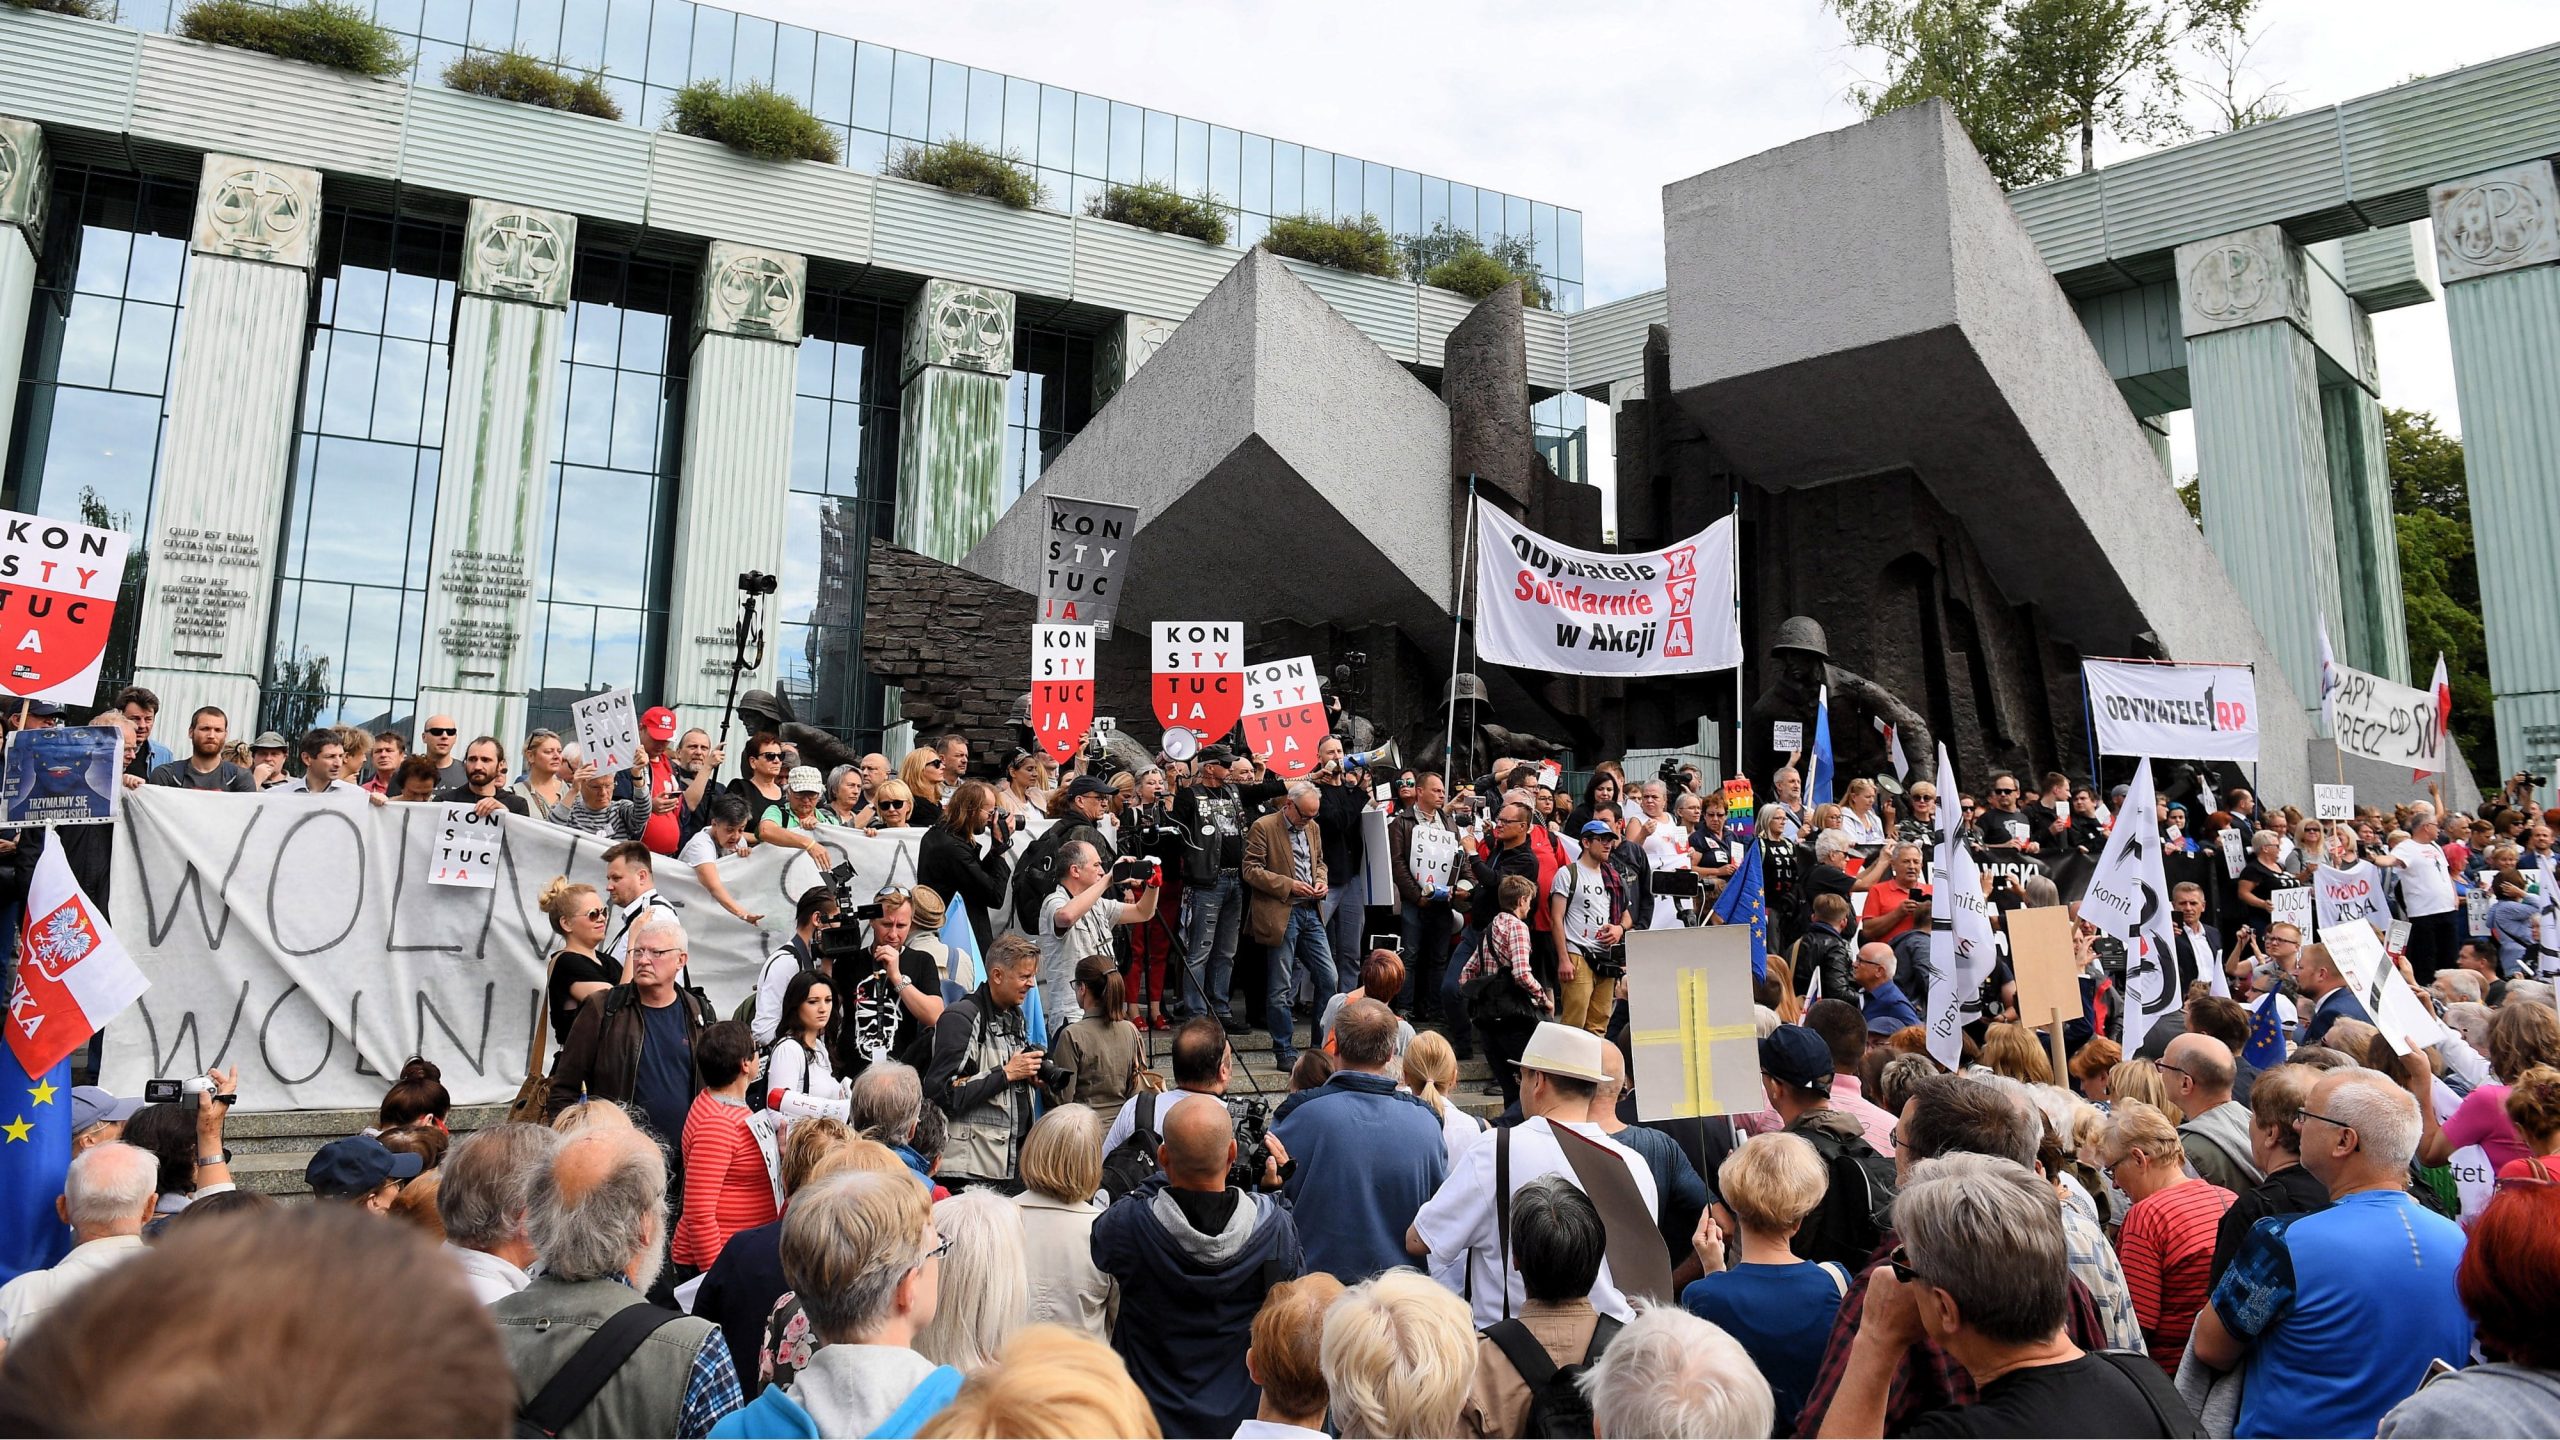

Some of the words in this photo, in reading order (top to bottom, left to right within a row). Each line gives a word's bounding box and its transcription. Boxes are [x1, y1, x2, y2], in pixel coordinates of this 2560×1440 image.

[169, 527, 199, 538] QUID
[204, 531, 221, 540] EST
[227, 533, 254, 542] ENIM
[1051, 511, 1122, 539] KON
[7, 519, 107, 557] KON
[163, 539, 203, 550] CIVITAS
[1049, 541, 1117, 567] STY
[1511, 534, 1657, 581] Obywatele
[1, 554, 98, 590] STY
[1048, 569, 1108, 595] TUC
[1515, 569, 1654, 616] Solidarnie
[1046, 599, 1077, 620] JA
[1044, 631, 1086, 648] KON
[1167, 627, 1229, 643] KON
[1556, 623, 1582, 648] w
[1588, 622, 1657, 658] Akcji
[1044, 658, 1085, 675] STY
[1168, 652, 1228, 668] STY
[1246, 662, 1303, 686] KON
[1044, 685, 1084, 703] TUC
[1168, 677, 1228, 693] TUC
[581, 696, 627, 718] KON
[1253, 686, 1305, 709] STY
[1168, 702, 1206, 720] JA
[1258, 709, 1312, 732] TUC
[2105, 695, 2208, 725] OBYWATELE
[2216, 702, 2247, 731] RP
[1042, 712, 1069, 732] JA
[2337, 711, 2387, 756] PRECZ
[2390, 707, 2411, 736] OD
[2406, 703, 2438, 758] SN
[588, 731, 631, 752] TUC
[1264, 735, 1299, 756] JA
[1728, 784, 1750, 793] KON
[2318, 787, 2347, 800] WOLNE
[29, 796, 73, 809] TRZYMAJMY
[1729, 796, 1751, 807] STY
[447, 809, 499, 827] KON
[1730, 810, 1750, 819] TUC
[443, 848, 491, 865] TUC
[1417, 858, 1448, 872] TUC
[438, 867, 468, 880] JA
